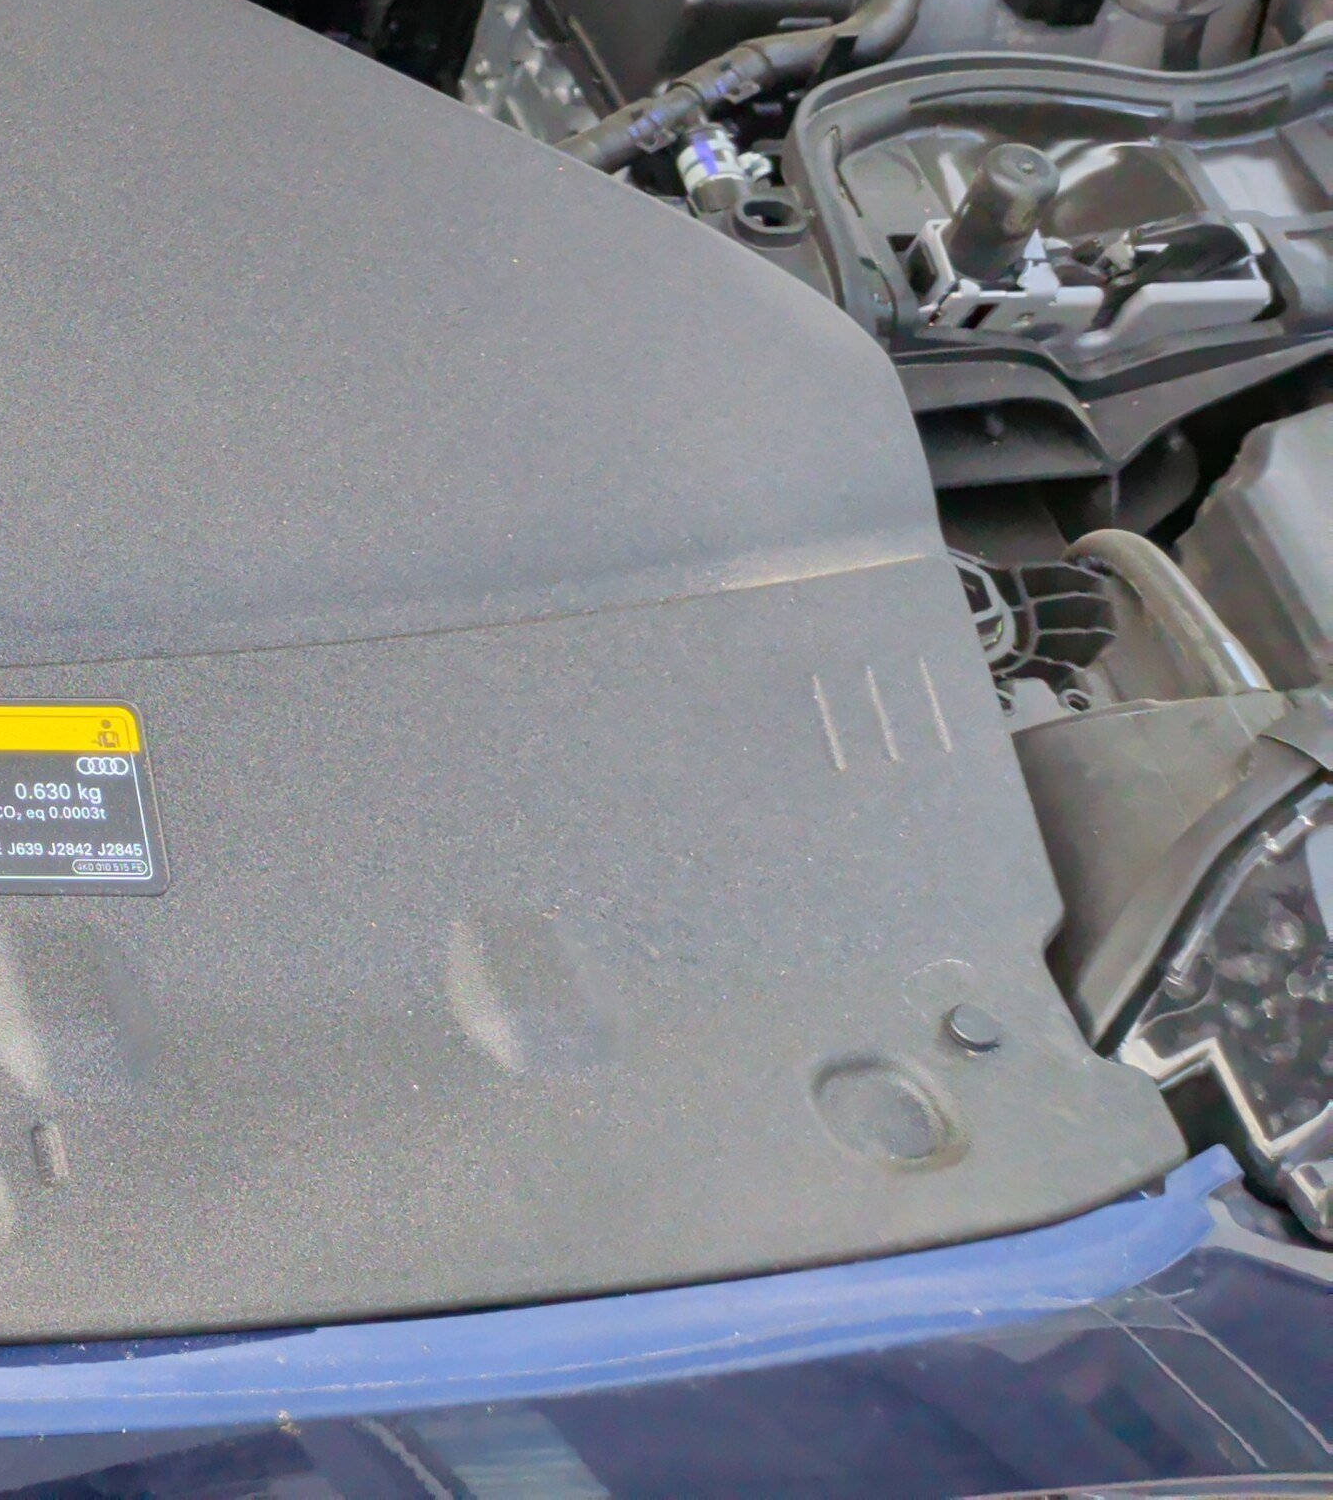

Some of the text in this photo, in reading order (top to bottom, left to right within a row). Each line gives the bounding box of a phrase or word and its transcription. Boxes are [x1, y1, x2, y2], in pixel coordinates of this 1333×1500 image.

[15, 783, 71, 800] 0.630
[77, 782, 102, 803] kg
[26, 809, 45, 821] eq
[49, 807, 106, 819] 0.0003t
[7, 842, 43, 856] J639
[48, 843, 92, 856] J2842
[97, 844, 143, 857] J2845
